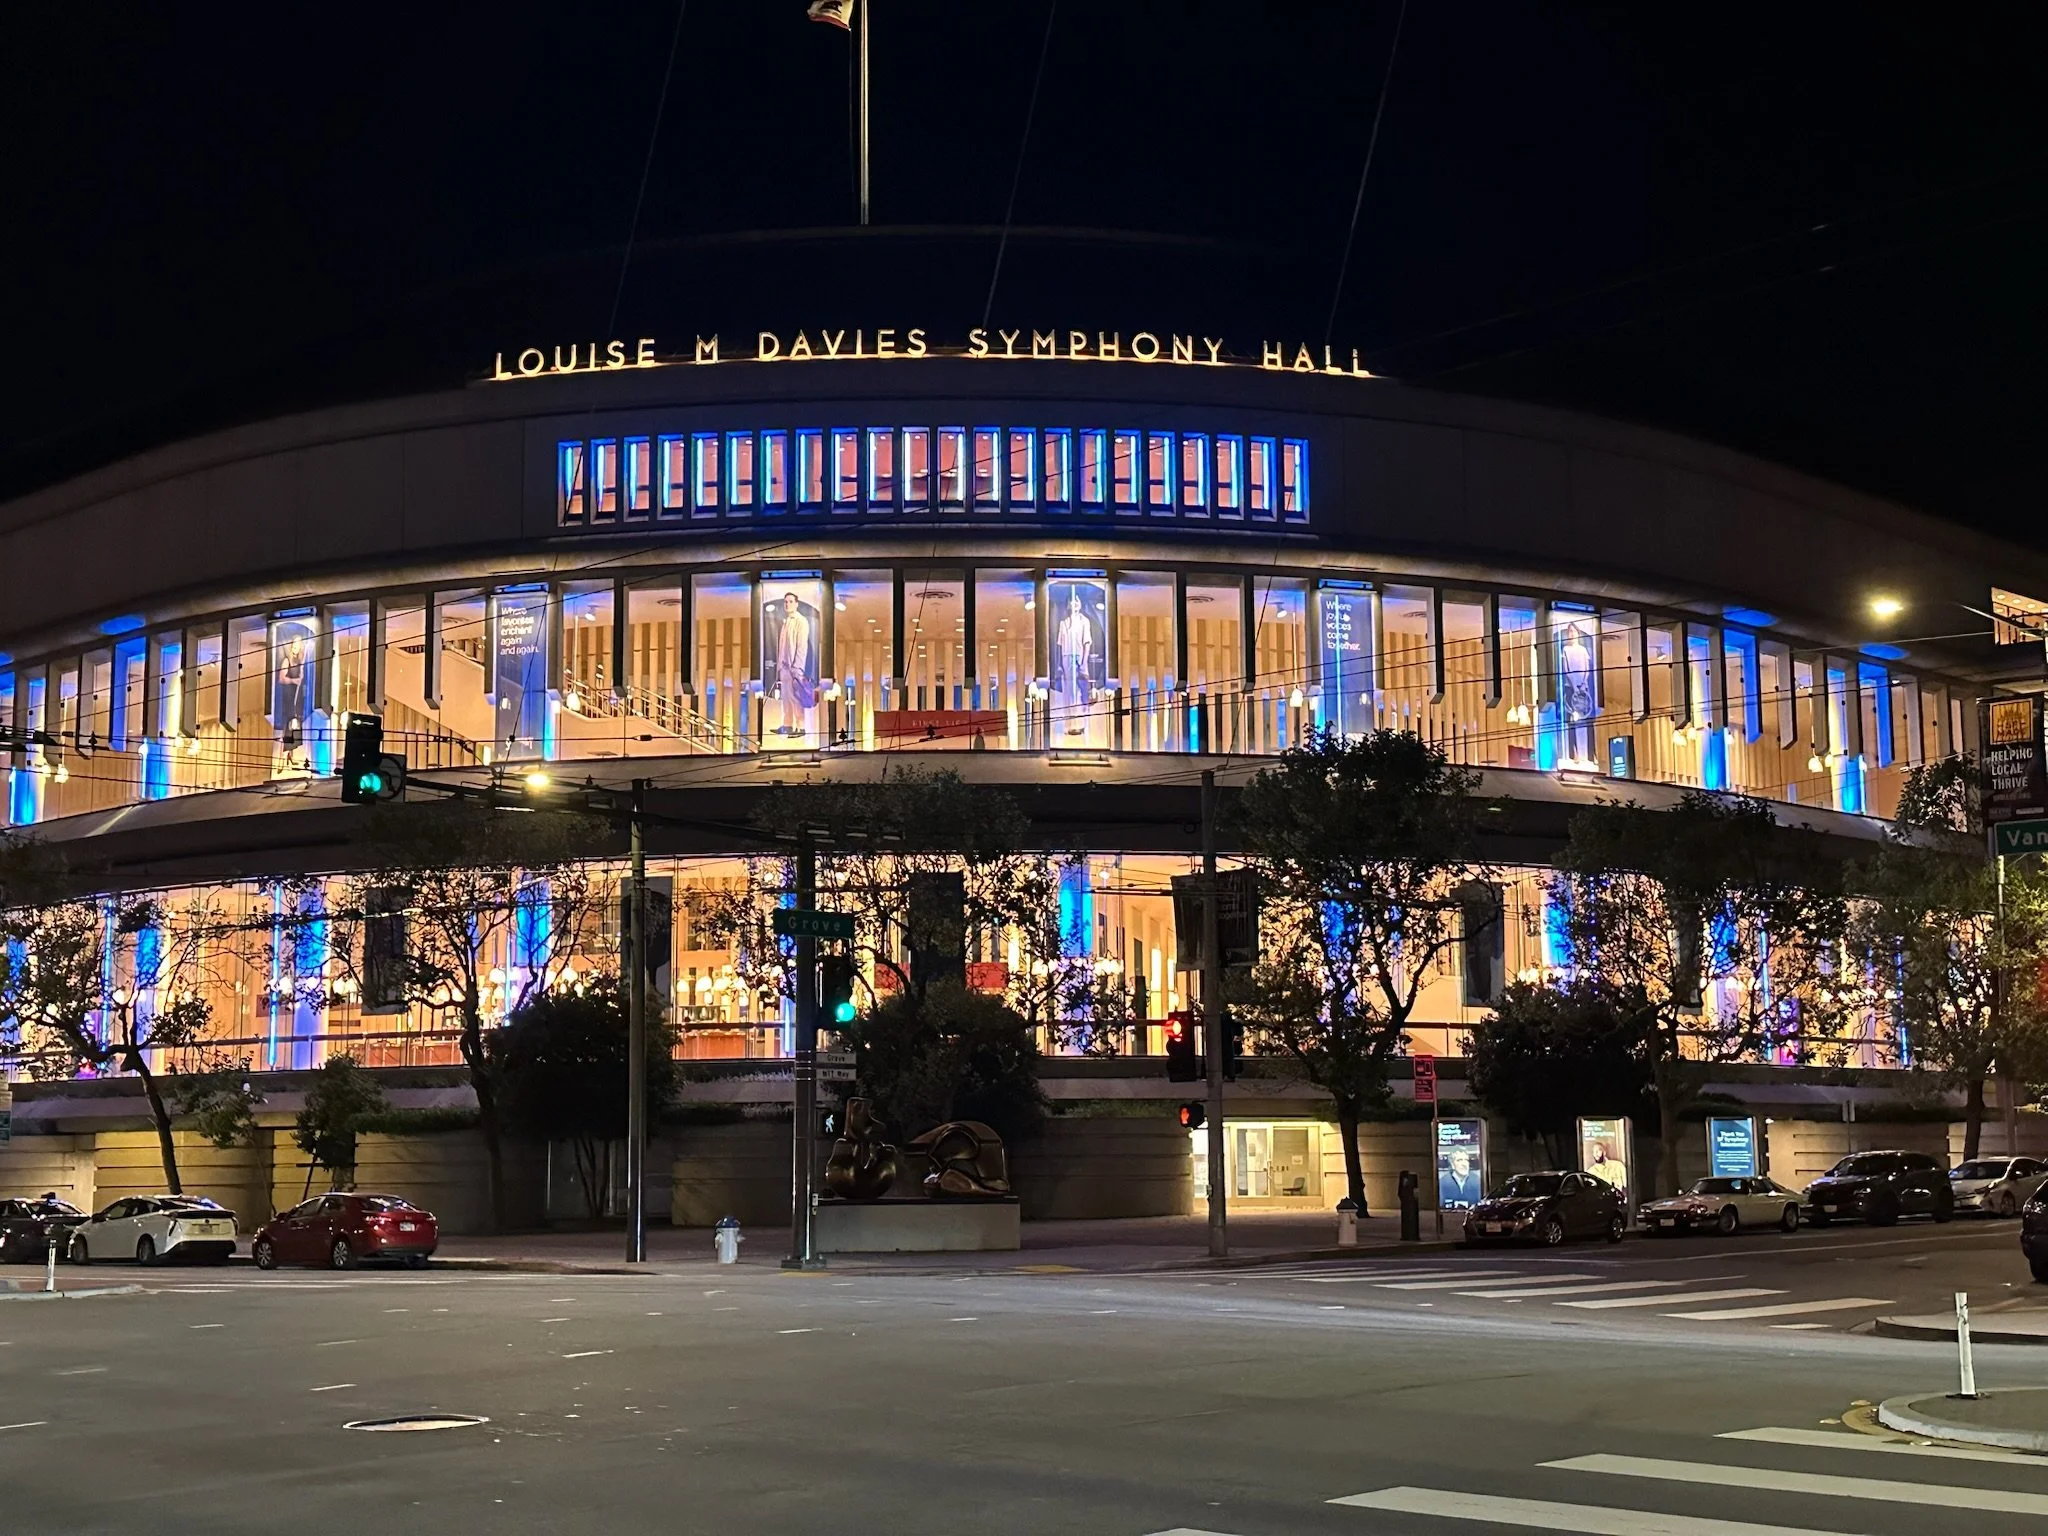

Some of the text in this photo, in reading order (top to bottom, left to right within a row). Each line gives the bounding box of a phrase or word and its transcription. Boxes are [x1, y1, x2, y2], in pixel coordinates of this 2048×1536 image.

[495, 328, 1371, 379] LOUISE M DAVIES SYMPHONY HALL
[500, 646, 516, 656] and
[1991, 747, 2034, 763] HELPING
[1991, 763, 2024, 776] LOCAL
[1991, 776, 2029, 790] THRIVE
[2006, 829, 2048, 847] Van
[787, 915, 841, 932] Grove
